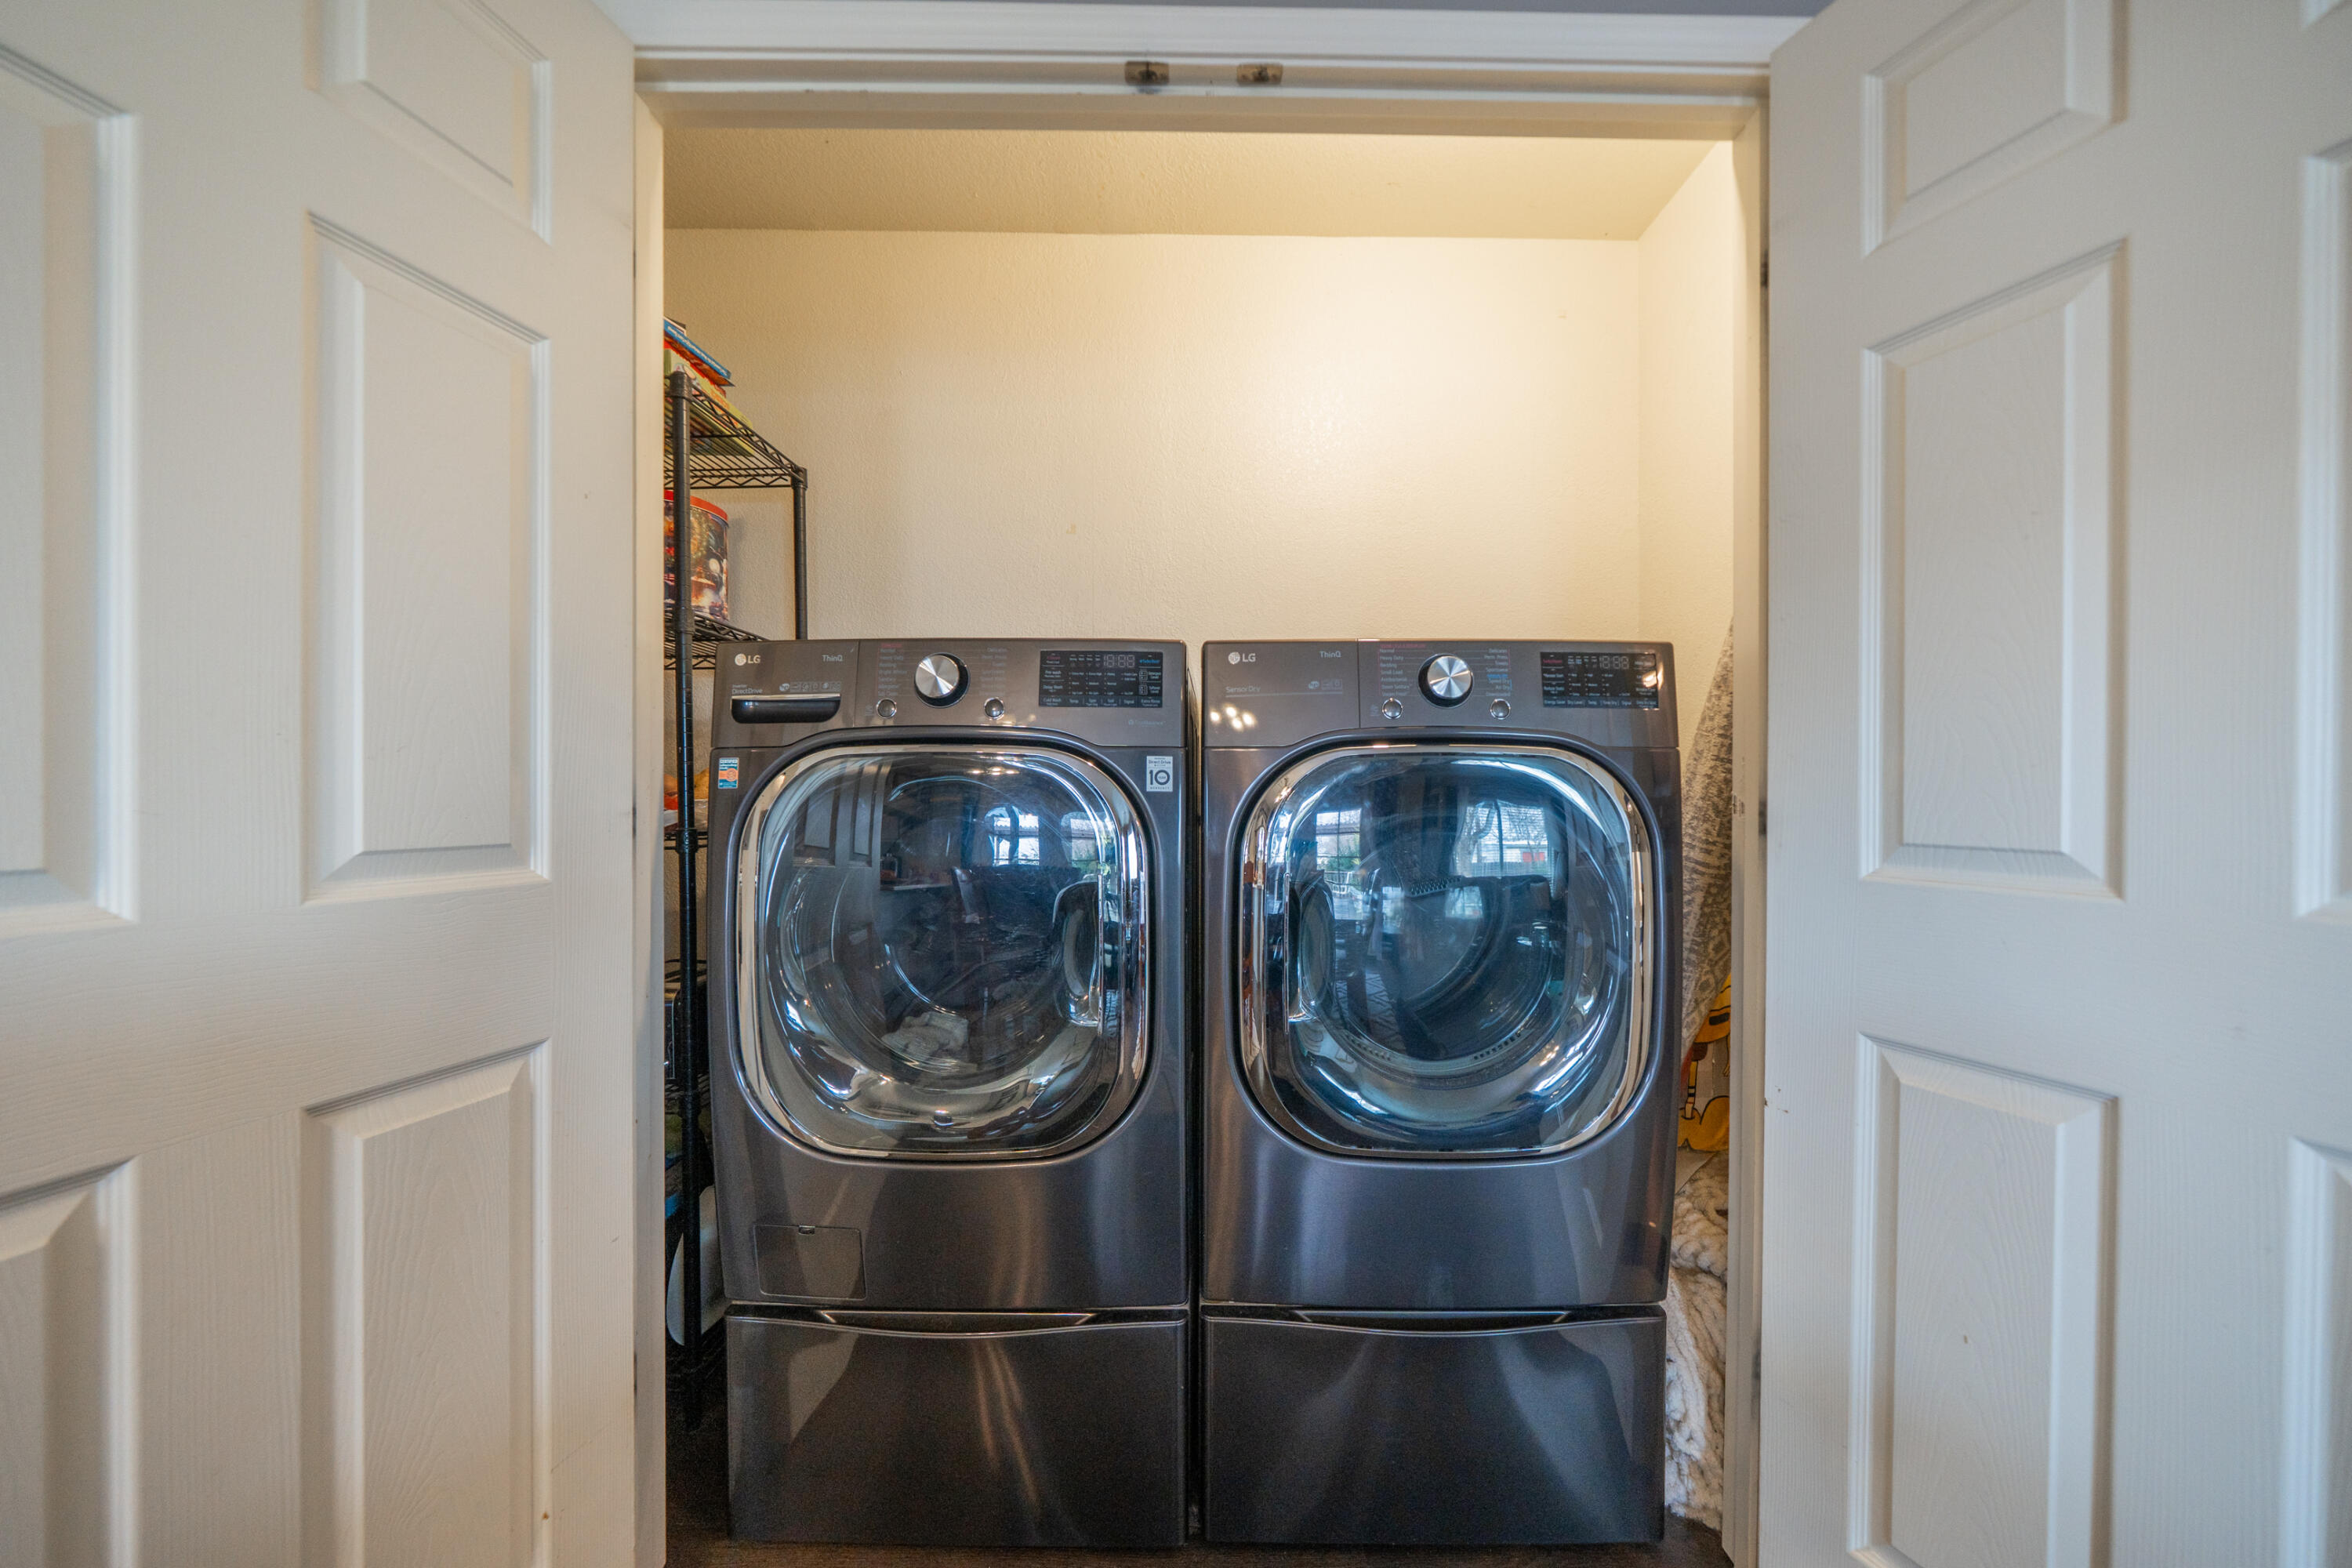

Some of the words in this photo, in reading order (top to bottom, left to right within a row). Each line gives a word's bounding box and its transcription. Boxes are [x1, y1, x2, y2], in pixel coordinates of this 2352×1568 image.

[748, 655, 761, 663] LG
[1242, 653, 1256, 662] LG
[1149, 769, 1171, 786] 10
